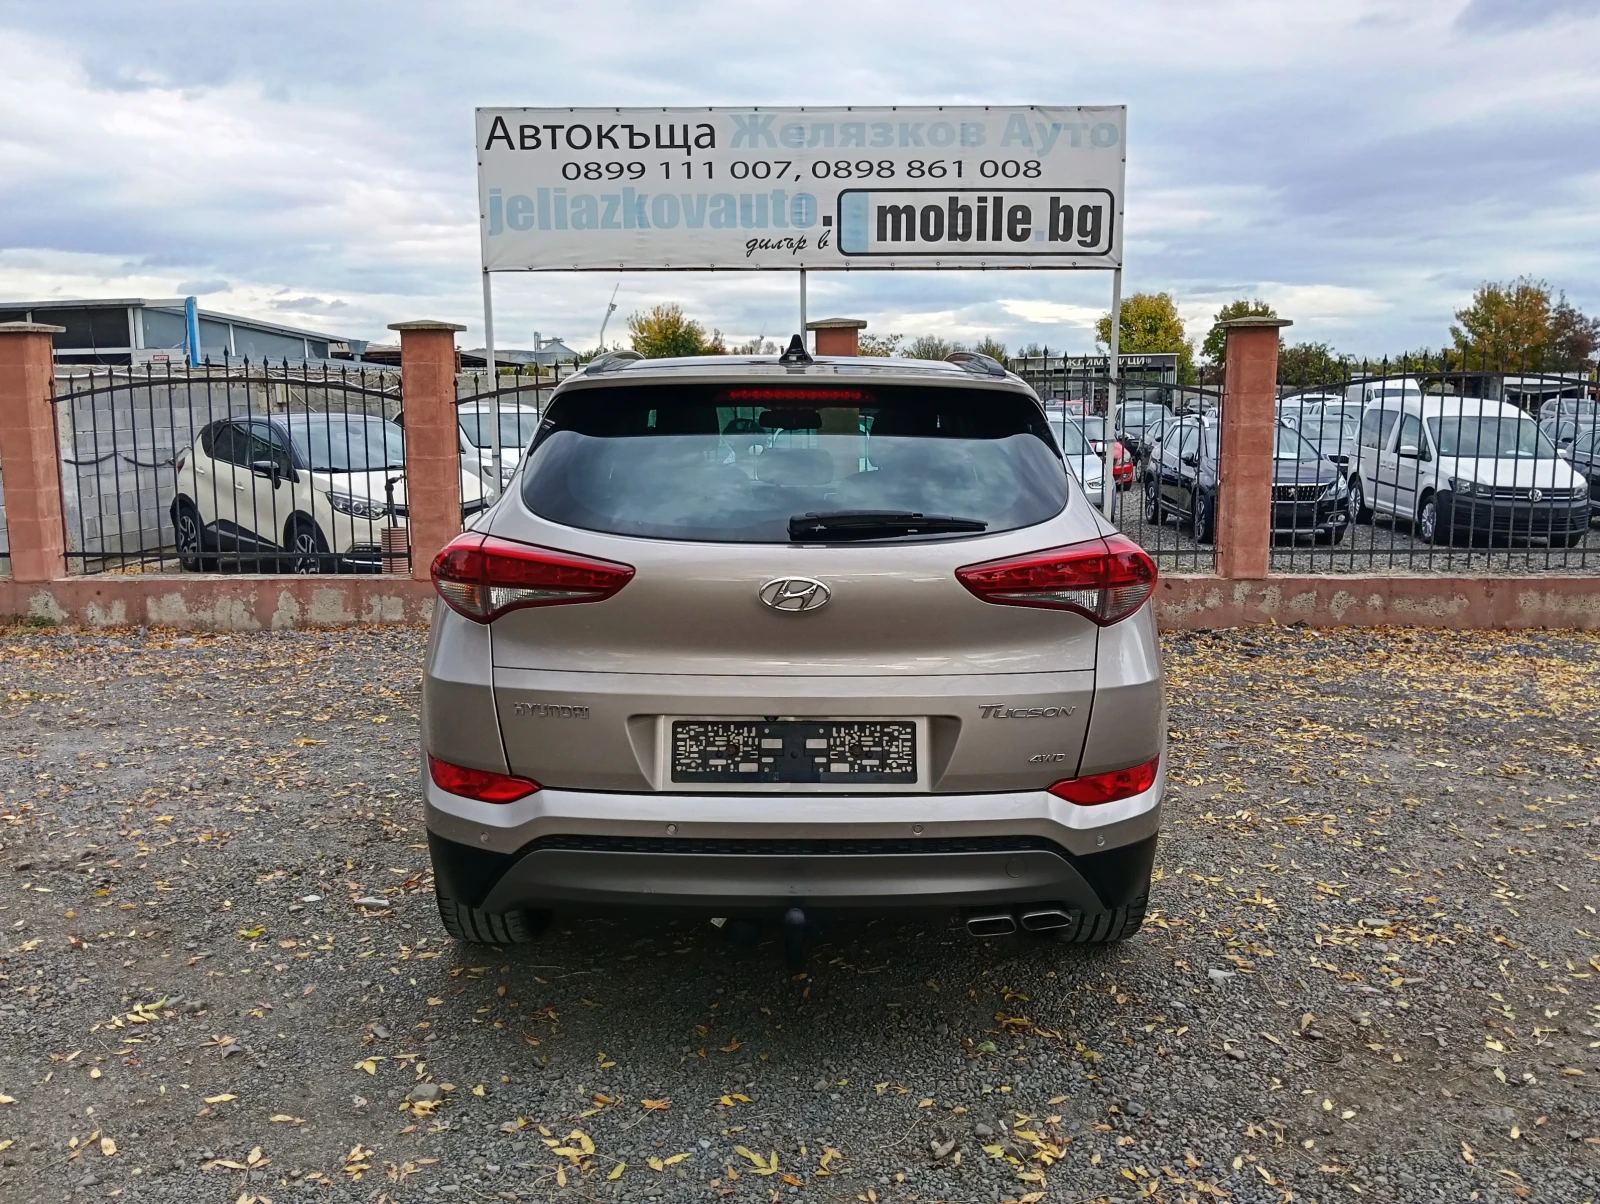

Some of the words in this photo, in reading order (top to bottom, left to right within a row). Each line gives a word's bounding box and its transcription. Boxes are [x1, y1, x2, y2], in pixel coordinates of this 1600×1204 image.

[485, 116, 716, 156] Автокъща
[729, 114, 986, 149] Желязков
[1000, 113, 1118, 158] Ауто
[562, 161, 646, 180] 0899
[659, 161, 713, 179] 111
[730, 161, 801, 182] 007,
[811, 160, 896, 179] 0898
[906, 160, 963, 178] 861
[979, 160, 1042, 178] 008
[877, 196, 1102, 248] mobile.bg
[746, 235, 808, 257] дилър
[514, 702, 589, 719] HYUNDAI
